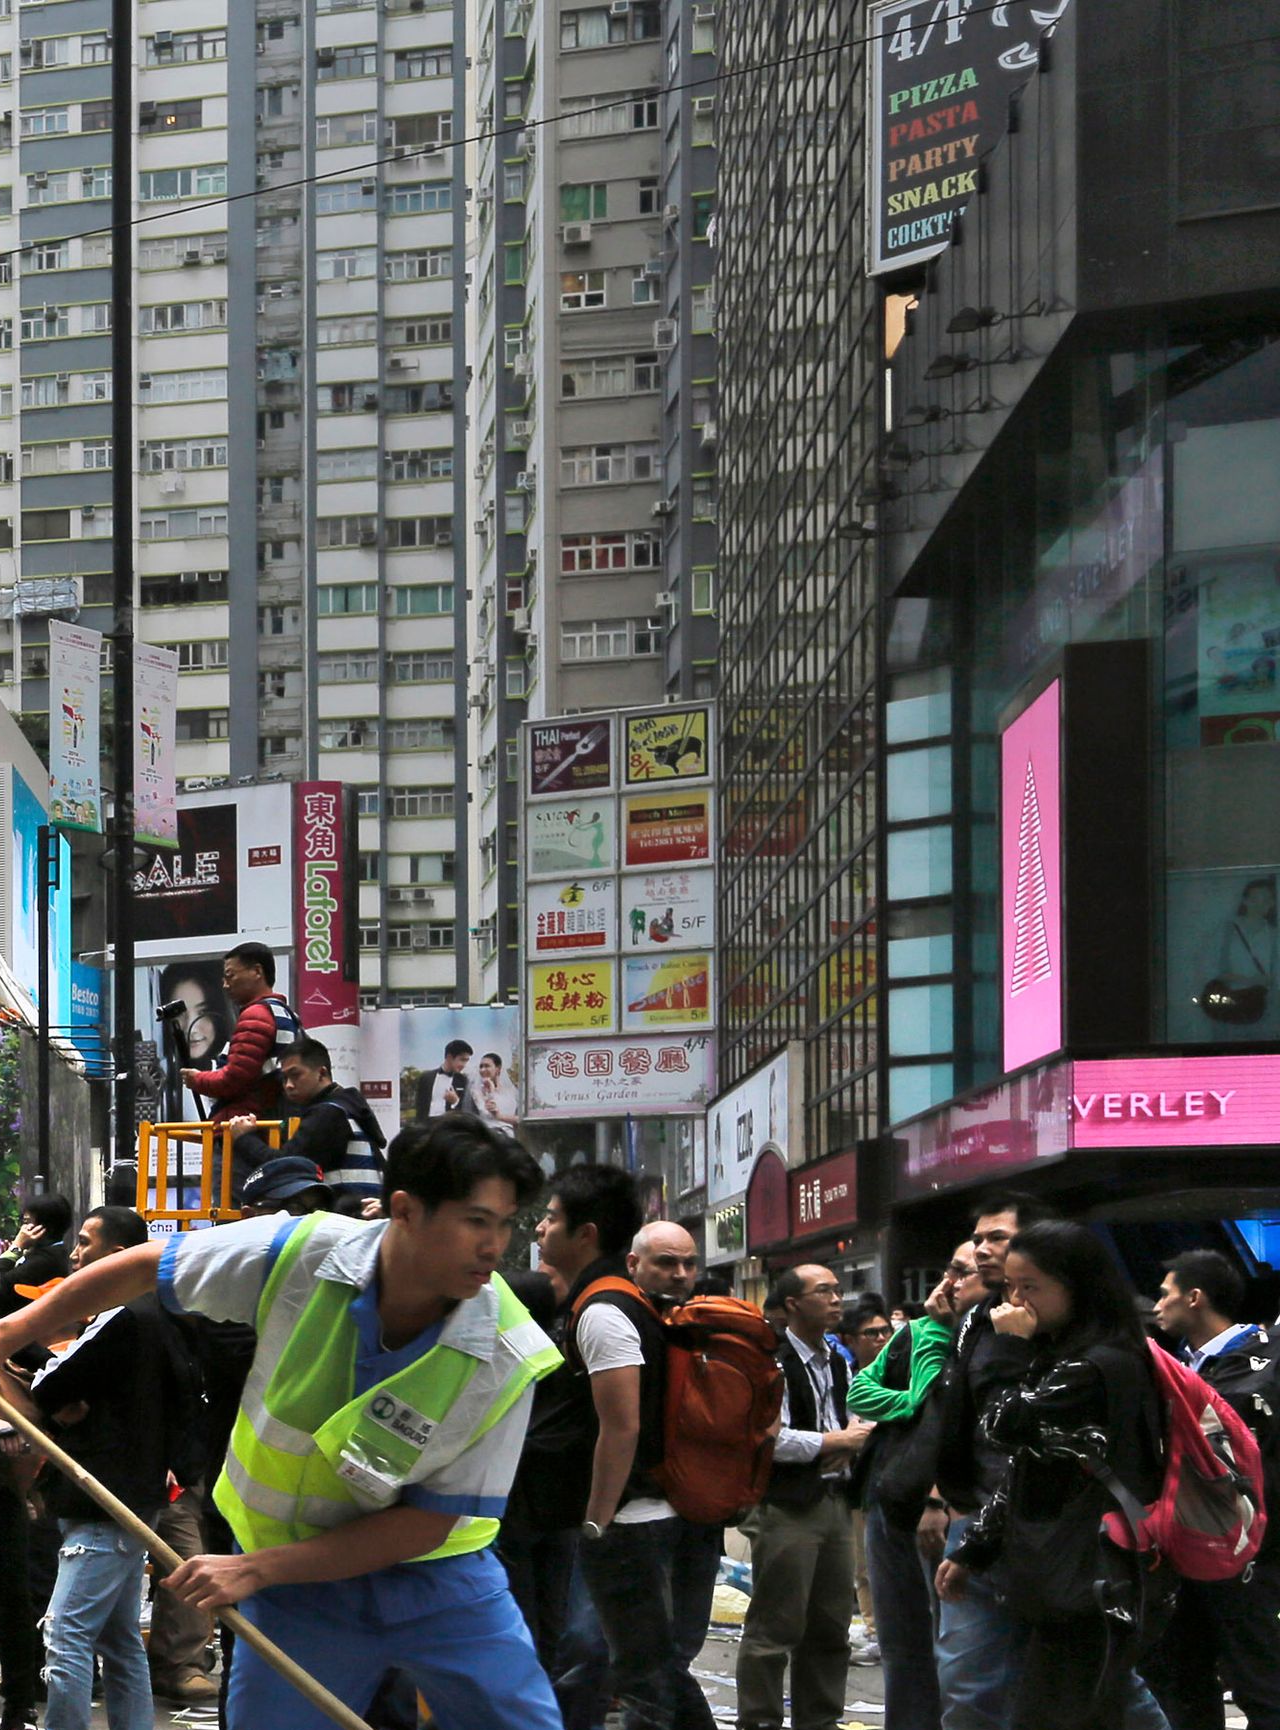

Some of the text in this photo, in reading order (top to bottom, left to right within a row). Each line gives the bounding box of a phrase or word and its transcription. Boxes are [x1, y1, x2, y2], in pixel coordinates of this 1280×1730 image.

[888, 67, 979, 115] PIZZA
[888, 99, 979, 149] PASTA
[888, 134, 980, 183] PARTY
[887, 169, 979, 217] SNACK
[534, 729, 560, 747] THAI
[304, 792, 336, 859] 東角
[592, 880, 612, 893] 6/F
[304, 860, 339, 974] Laforet
[681, 915, 706, 930] 5/F
[71, 982, 99, 1007] Bestco
[534, 990, 608, 1013] 酸辣粉
[590, 1014, 609, 1027] 5/F
[690, 1009, 708, 1021] 5/F
[683, 1036, 711, 1054] 4/F
[546, 1046, 690, 1080] 花園餐廳
[554, 1084, 639, 1102] Venus Garden
